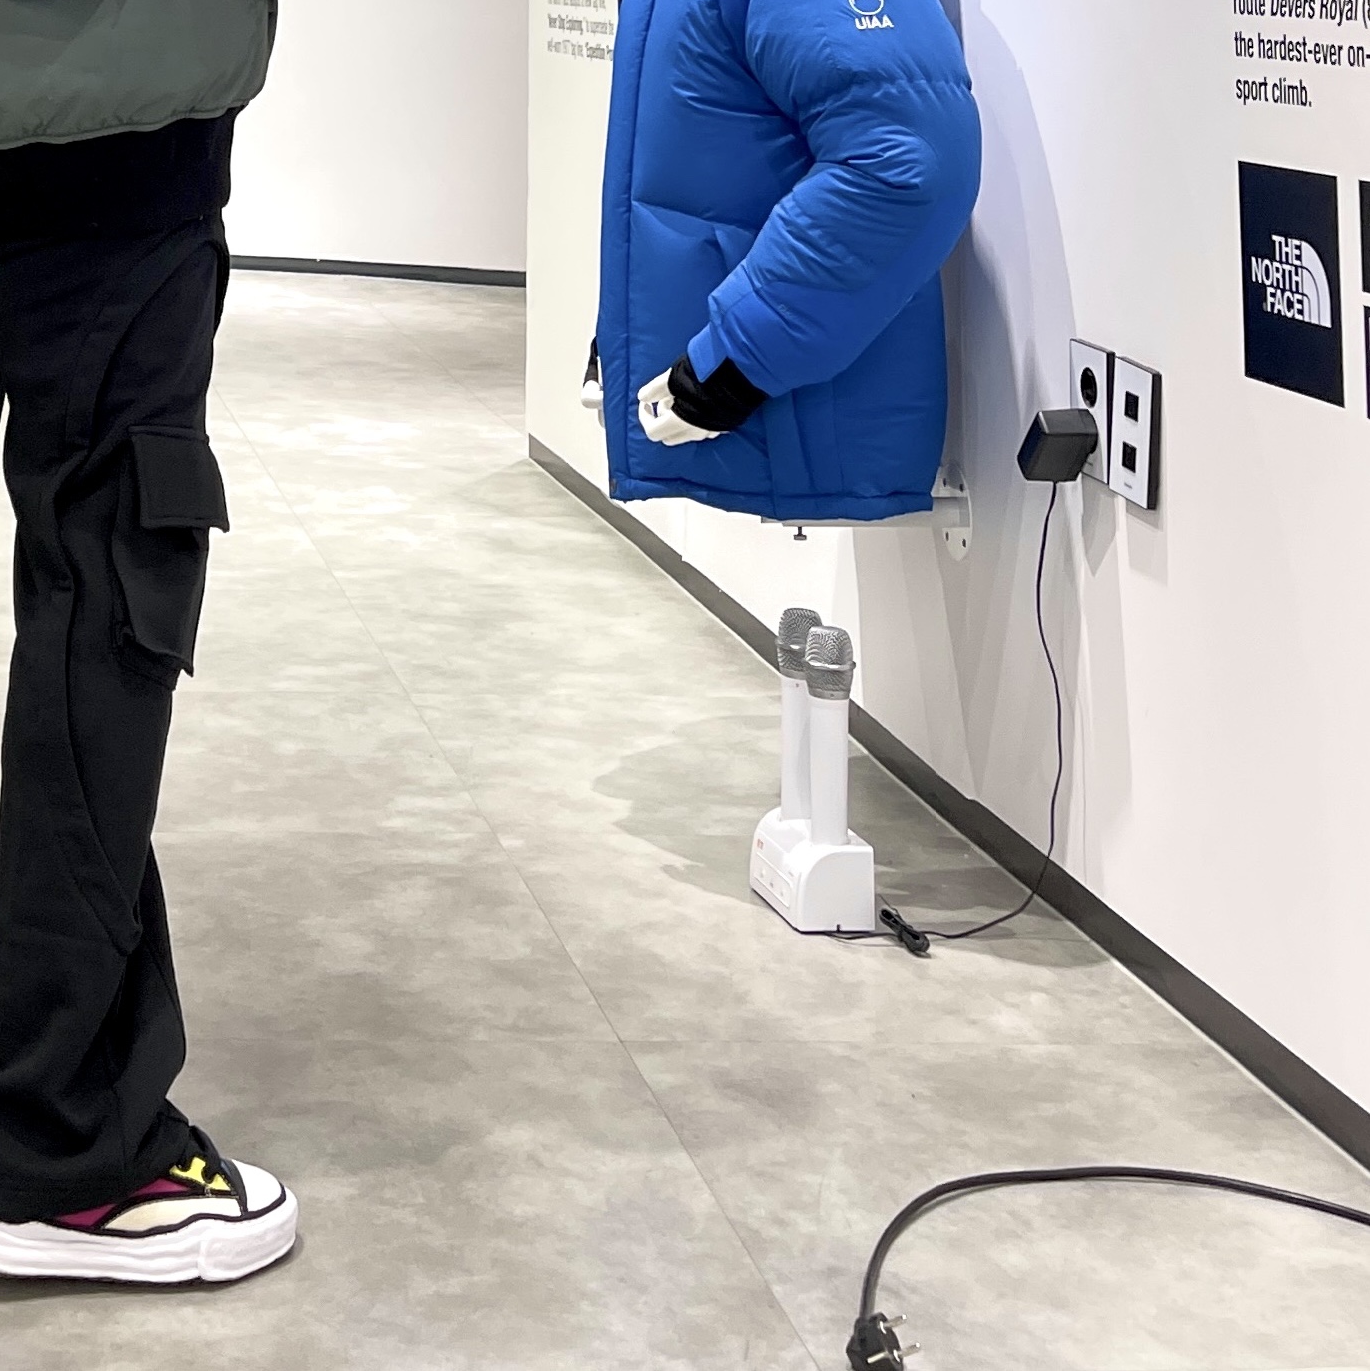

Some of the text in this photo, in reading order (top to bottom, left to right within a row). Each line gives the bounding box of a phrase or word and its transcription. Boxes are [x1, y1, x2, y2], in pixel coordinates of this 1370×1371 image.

[855, 14, 894, 30] UIAA
[1234, 31, 1254, 58] the
[1258, 32, 1343, 66] hardest-ever
[1235, 76, 1312, 108] sport climb.
[1271, 234, 1301, 266] THE
[1250, 256, 1302, 293] NORTH
[1265, 286, 1303, 320] FACE
